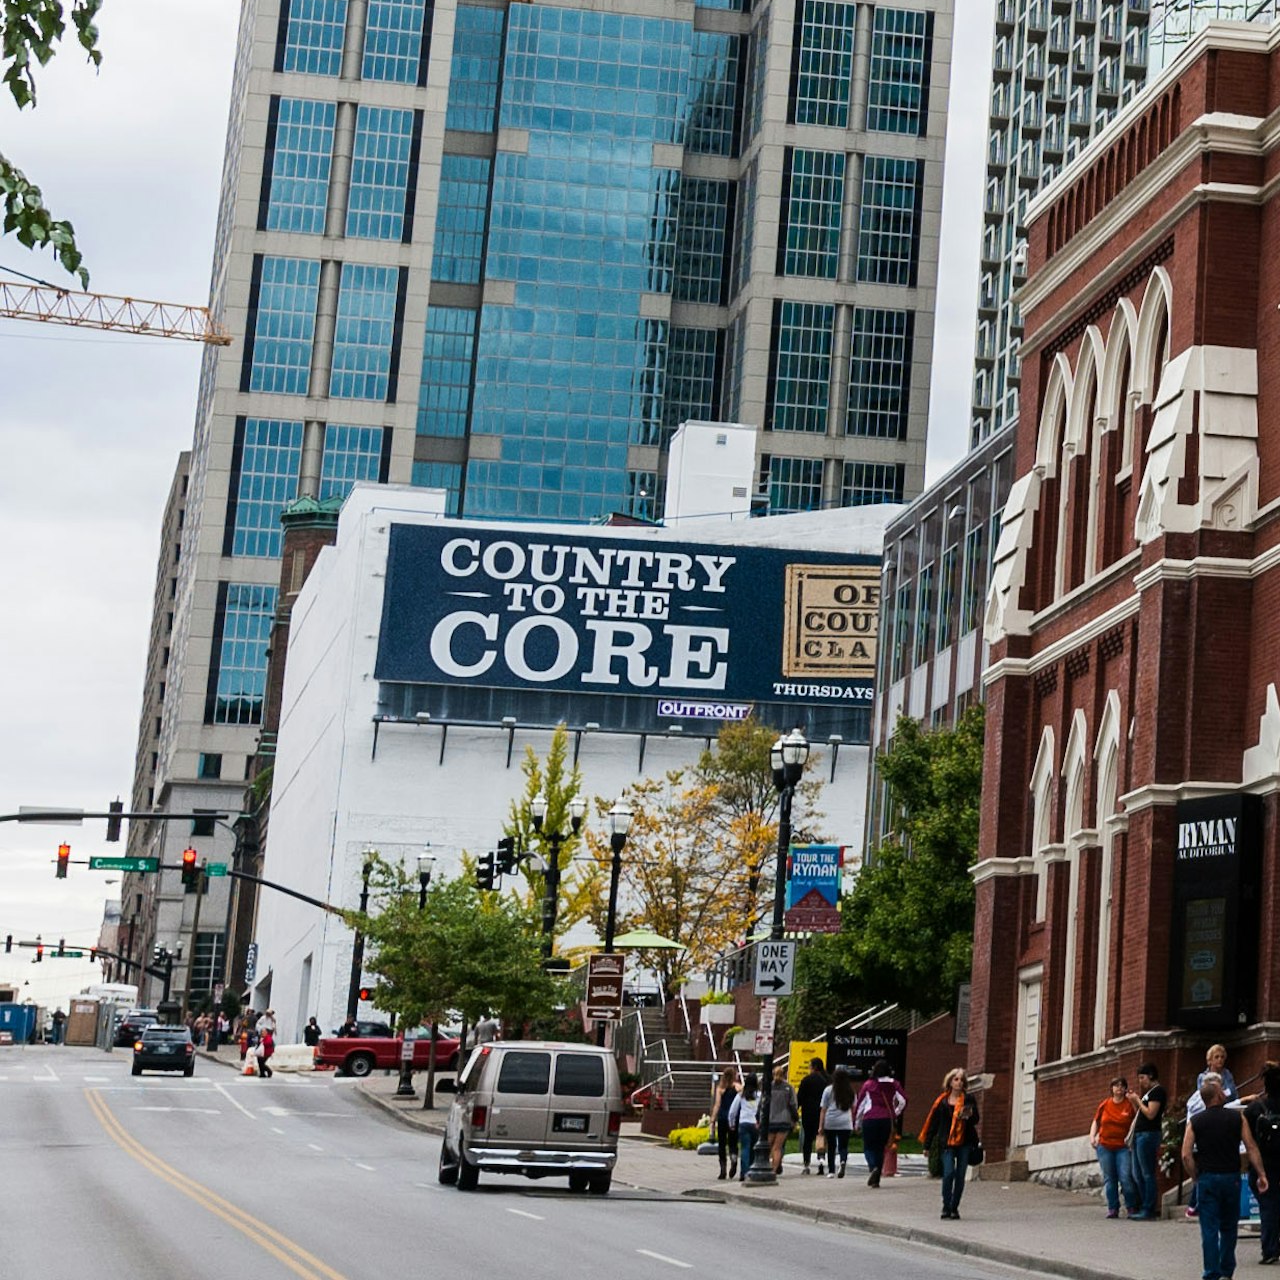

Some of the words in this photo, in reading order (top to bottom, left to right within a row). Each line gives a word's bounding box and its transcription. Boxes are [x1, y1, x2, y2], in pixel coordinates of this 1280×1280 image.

[440, 538, 736, 593] COUNTRY
[503, 582, 565, 614] TO
[576, 587, 670, 620] THE
[430, 610, 730, 690] CORE
[772, 682, 875, 700] THURSDAYS
[660, 702, 748, 718] OUTFRONT
[1178, 817, 1237, 849] RYMAN
[796, 853, 818, 863] TOUR
[820, 853, 836, 863] THE
[1177, 844, 1236, 860] AUDITORIUM
[792, 863, 838, 877] RYMAN
[762, 945, 788, 958] ONE
[760, 960, 788, 973] WAY
[847, 1049, 862, 1057] FOR
[863, 1049, 886, 1057] LEASE
